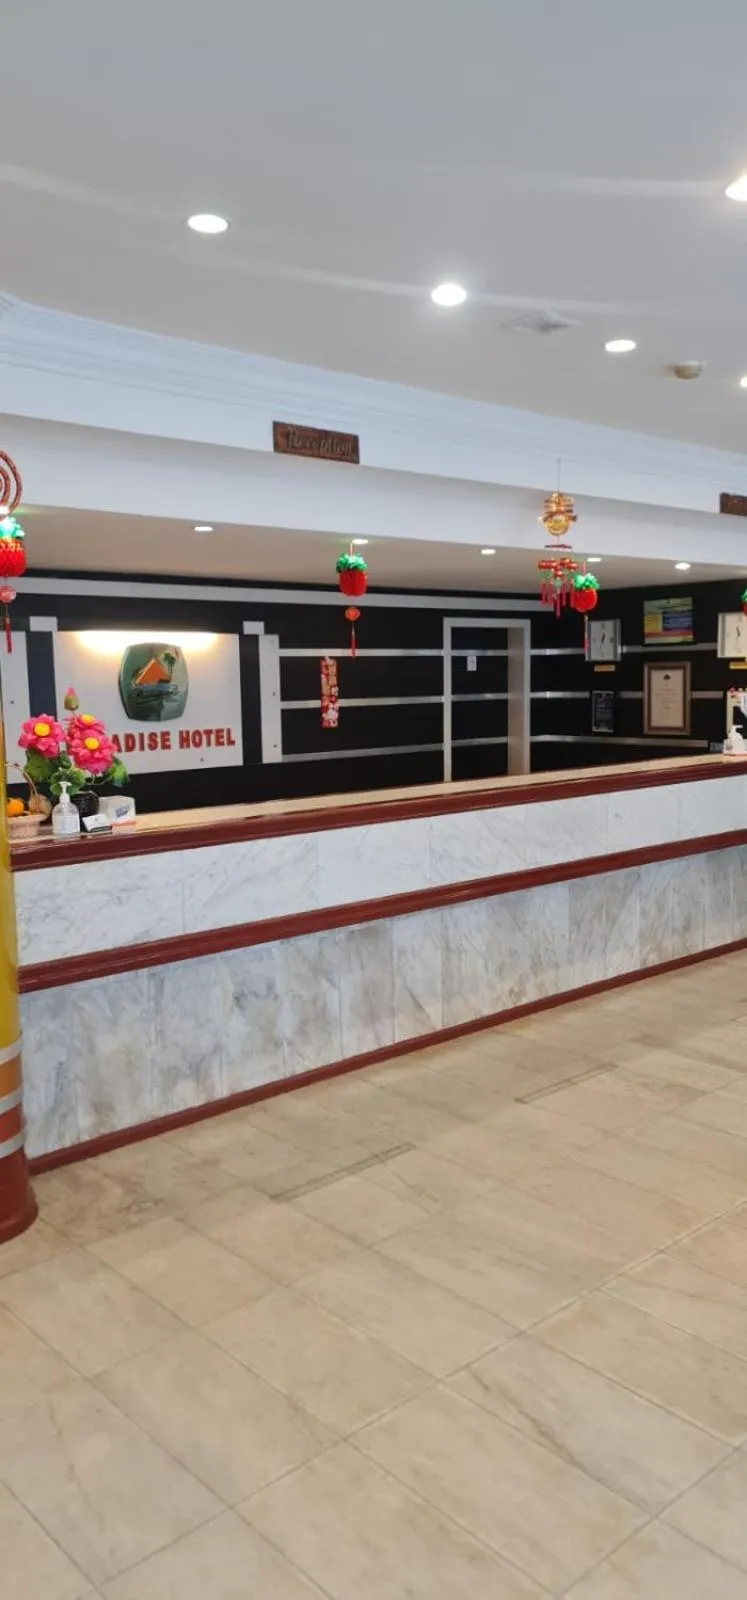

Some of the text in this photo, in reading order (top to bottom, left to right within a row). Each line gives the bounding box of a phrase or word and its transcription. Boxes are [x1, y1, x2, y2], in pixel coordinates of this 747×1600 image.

[286, 427, 352, 456] Reception
[111, 728, 235, 753] ADISE HOTEL
